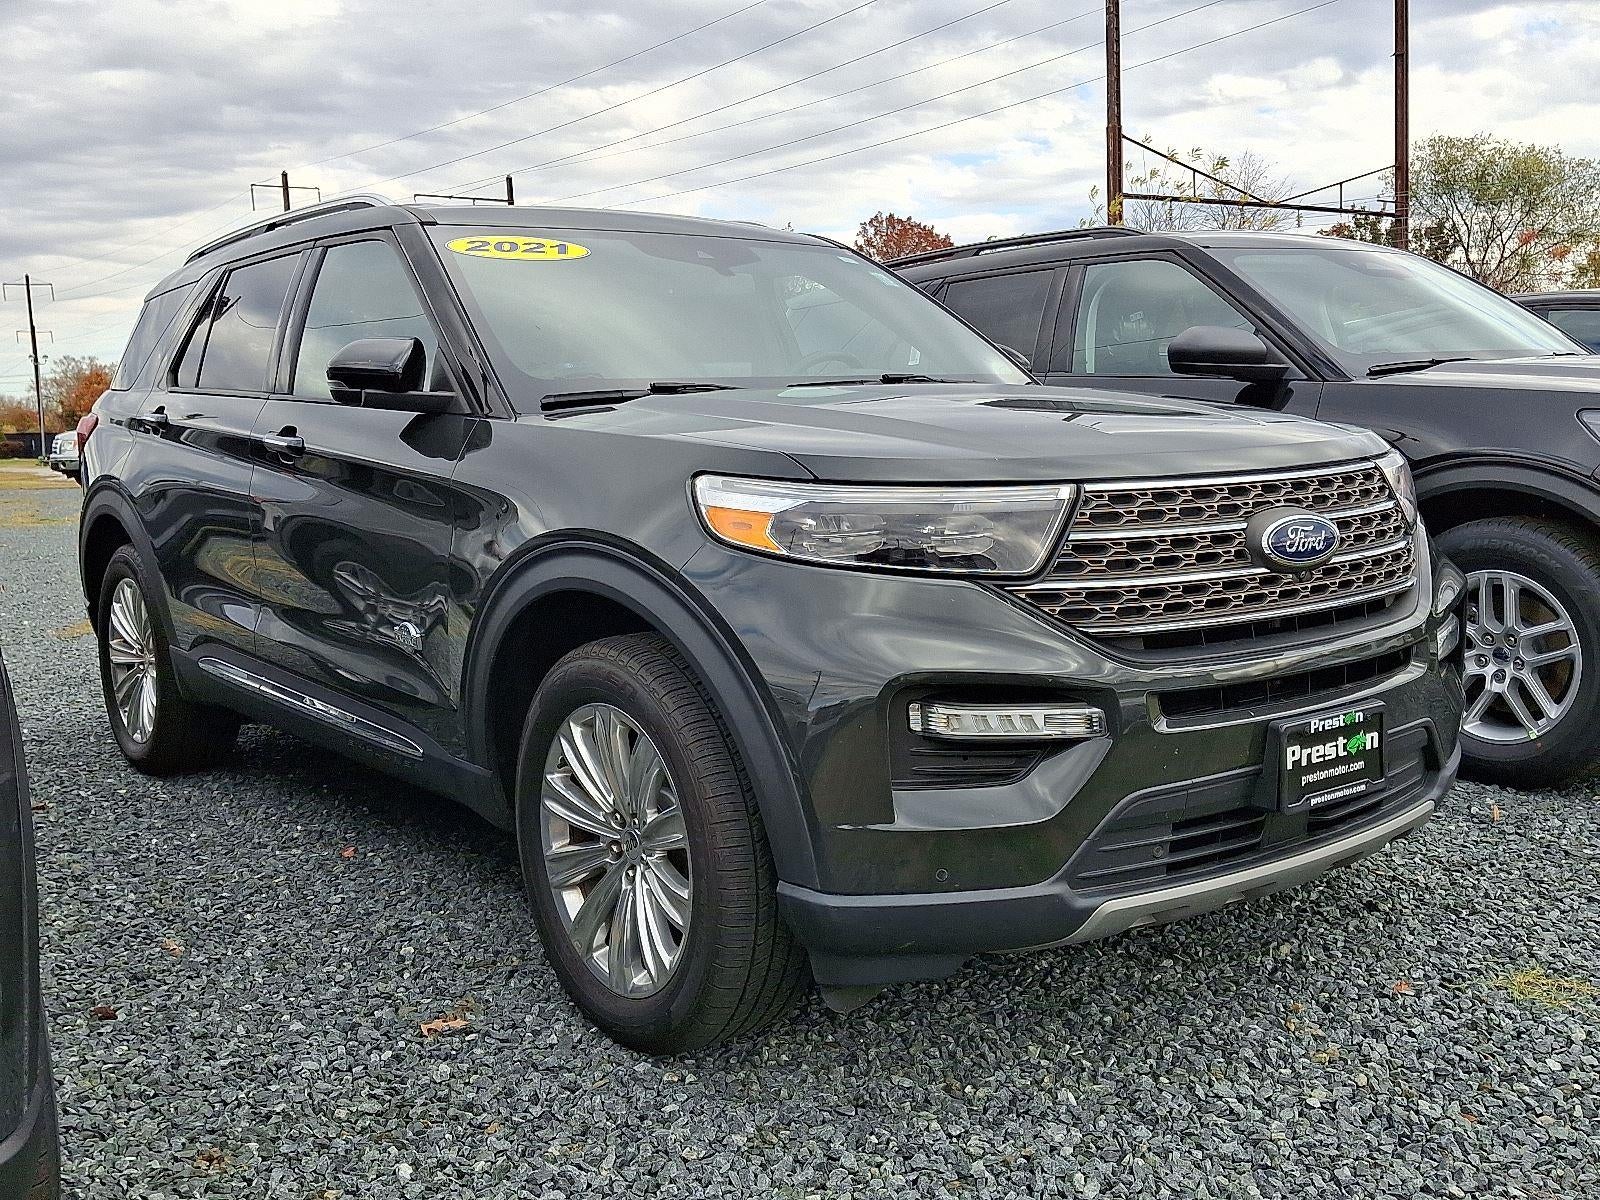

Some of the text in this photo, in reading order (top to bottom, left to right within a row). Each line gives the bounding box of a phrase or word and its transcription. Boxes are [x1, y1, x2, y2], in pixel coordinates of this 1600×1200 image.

[464, 240, 568, 255] 2021
[1285, 525, 1327, 552] Ford
[1301, 760, 1365, 787] prestonmotor.com
[1310, 784, 1366, 806] prestonmotor.com
